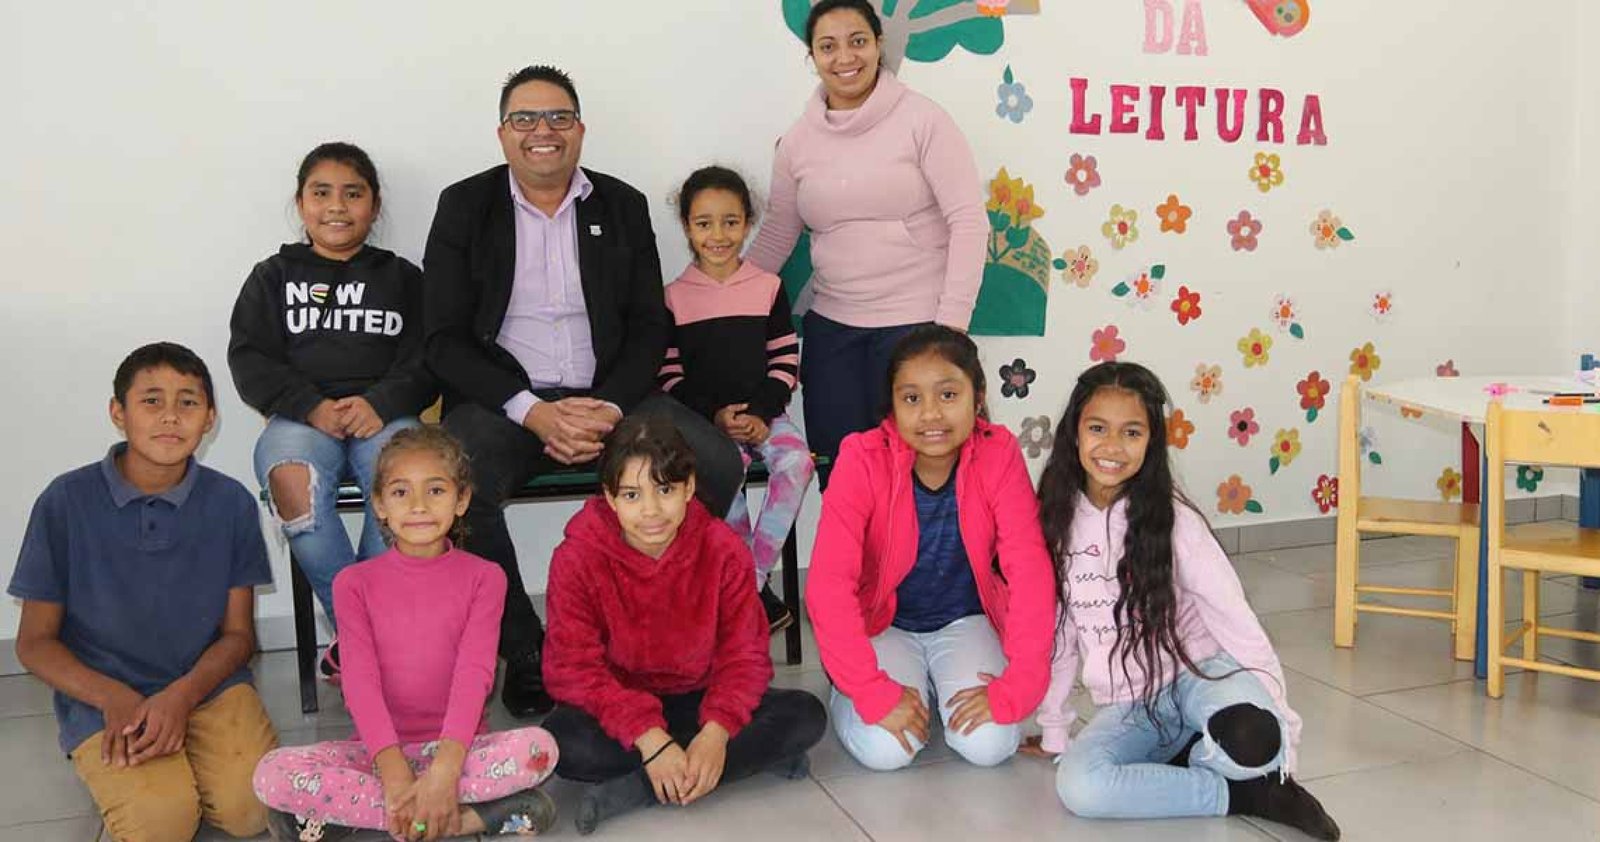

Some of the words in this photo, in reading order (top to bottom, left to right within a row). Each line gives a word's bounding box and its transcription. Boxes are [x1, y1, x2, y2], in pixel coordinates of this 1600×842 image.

[1142, 0, 1208, 56] DA
[1069, 77, 1327, 146] LEITURA
[285, 281, 366, 305] NOW
[286, 307, 404, 336] UNITED
